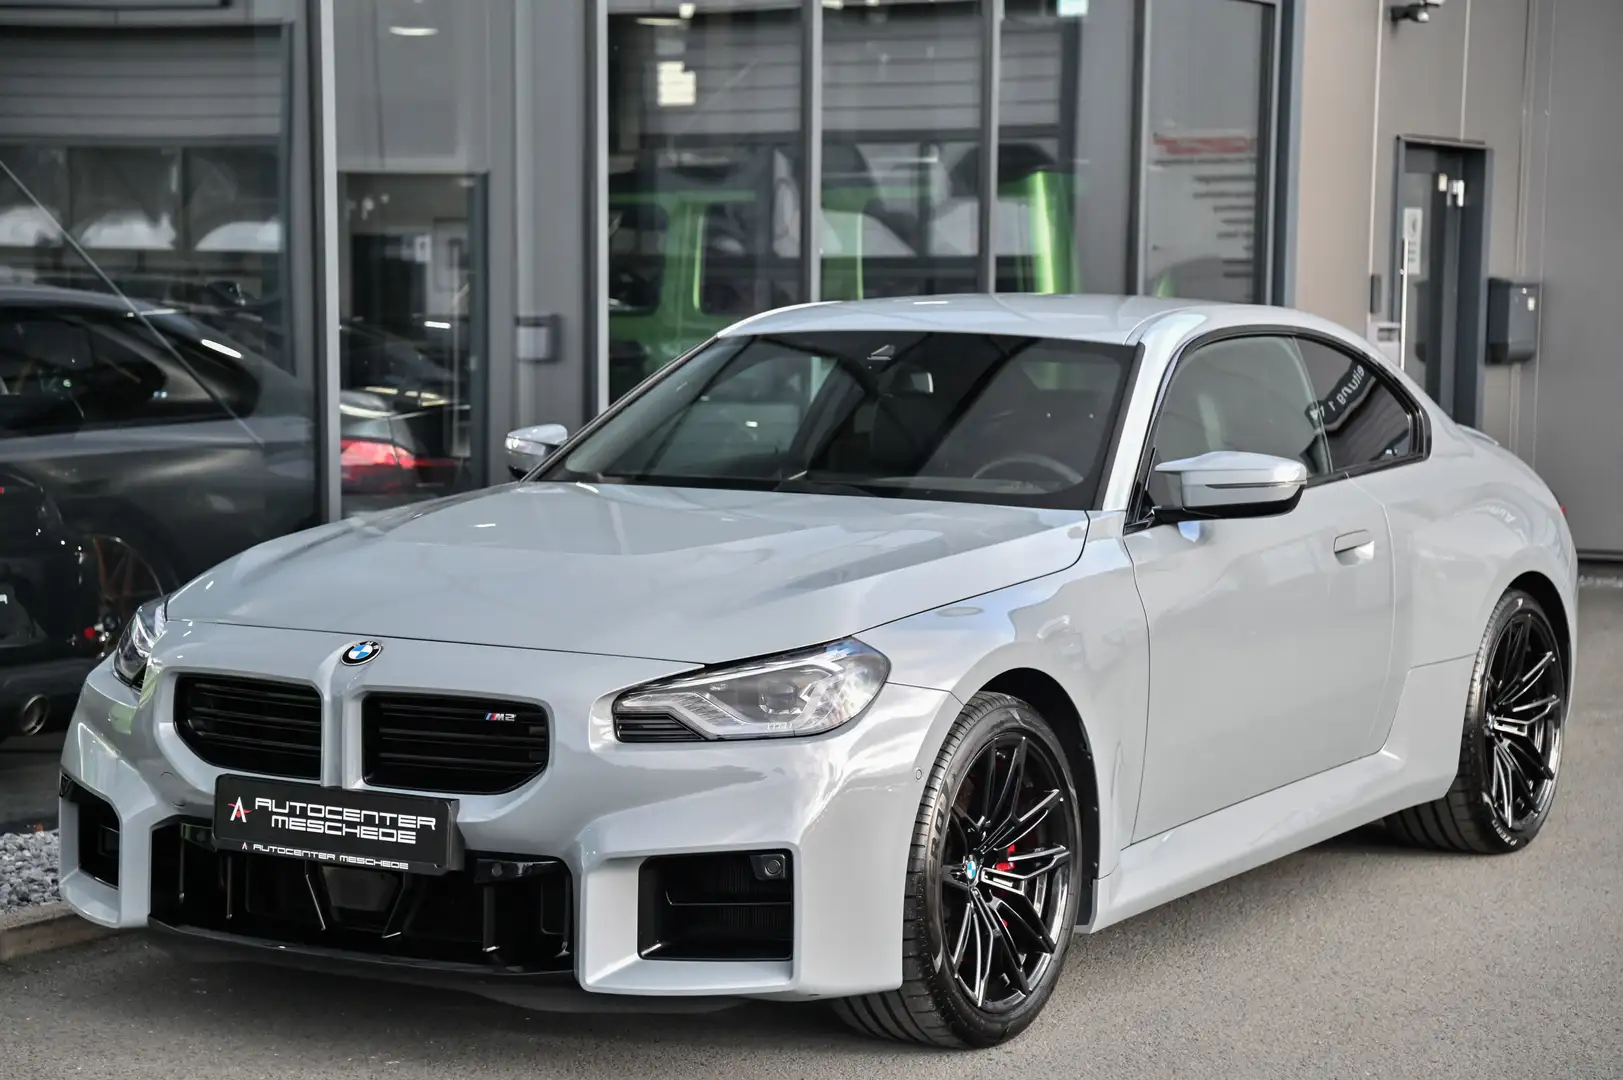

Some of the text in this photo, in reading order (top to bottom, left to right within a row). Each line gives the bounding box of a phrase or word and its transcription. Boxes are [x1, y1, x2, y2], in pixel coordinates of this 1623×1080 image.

[255, 797, 436, 830] AUTOCENTER
[271, 815, 416, 844] MESCHEDE
[253, 843, 409, 870] AUTOCENTER MESCHEDE
